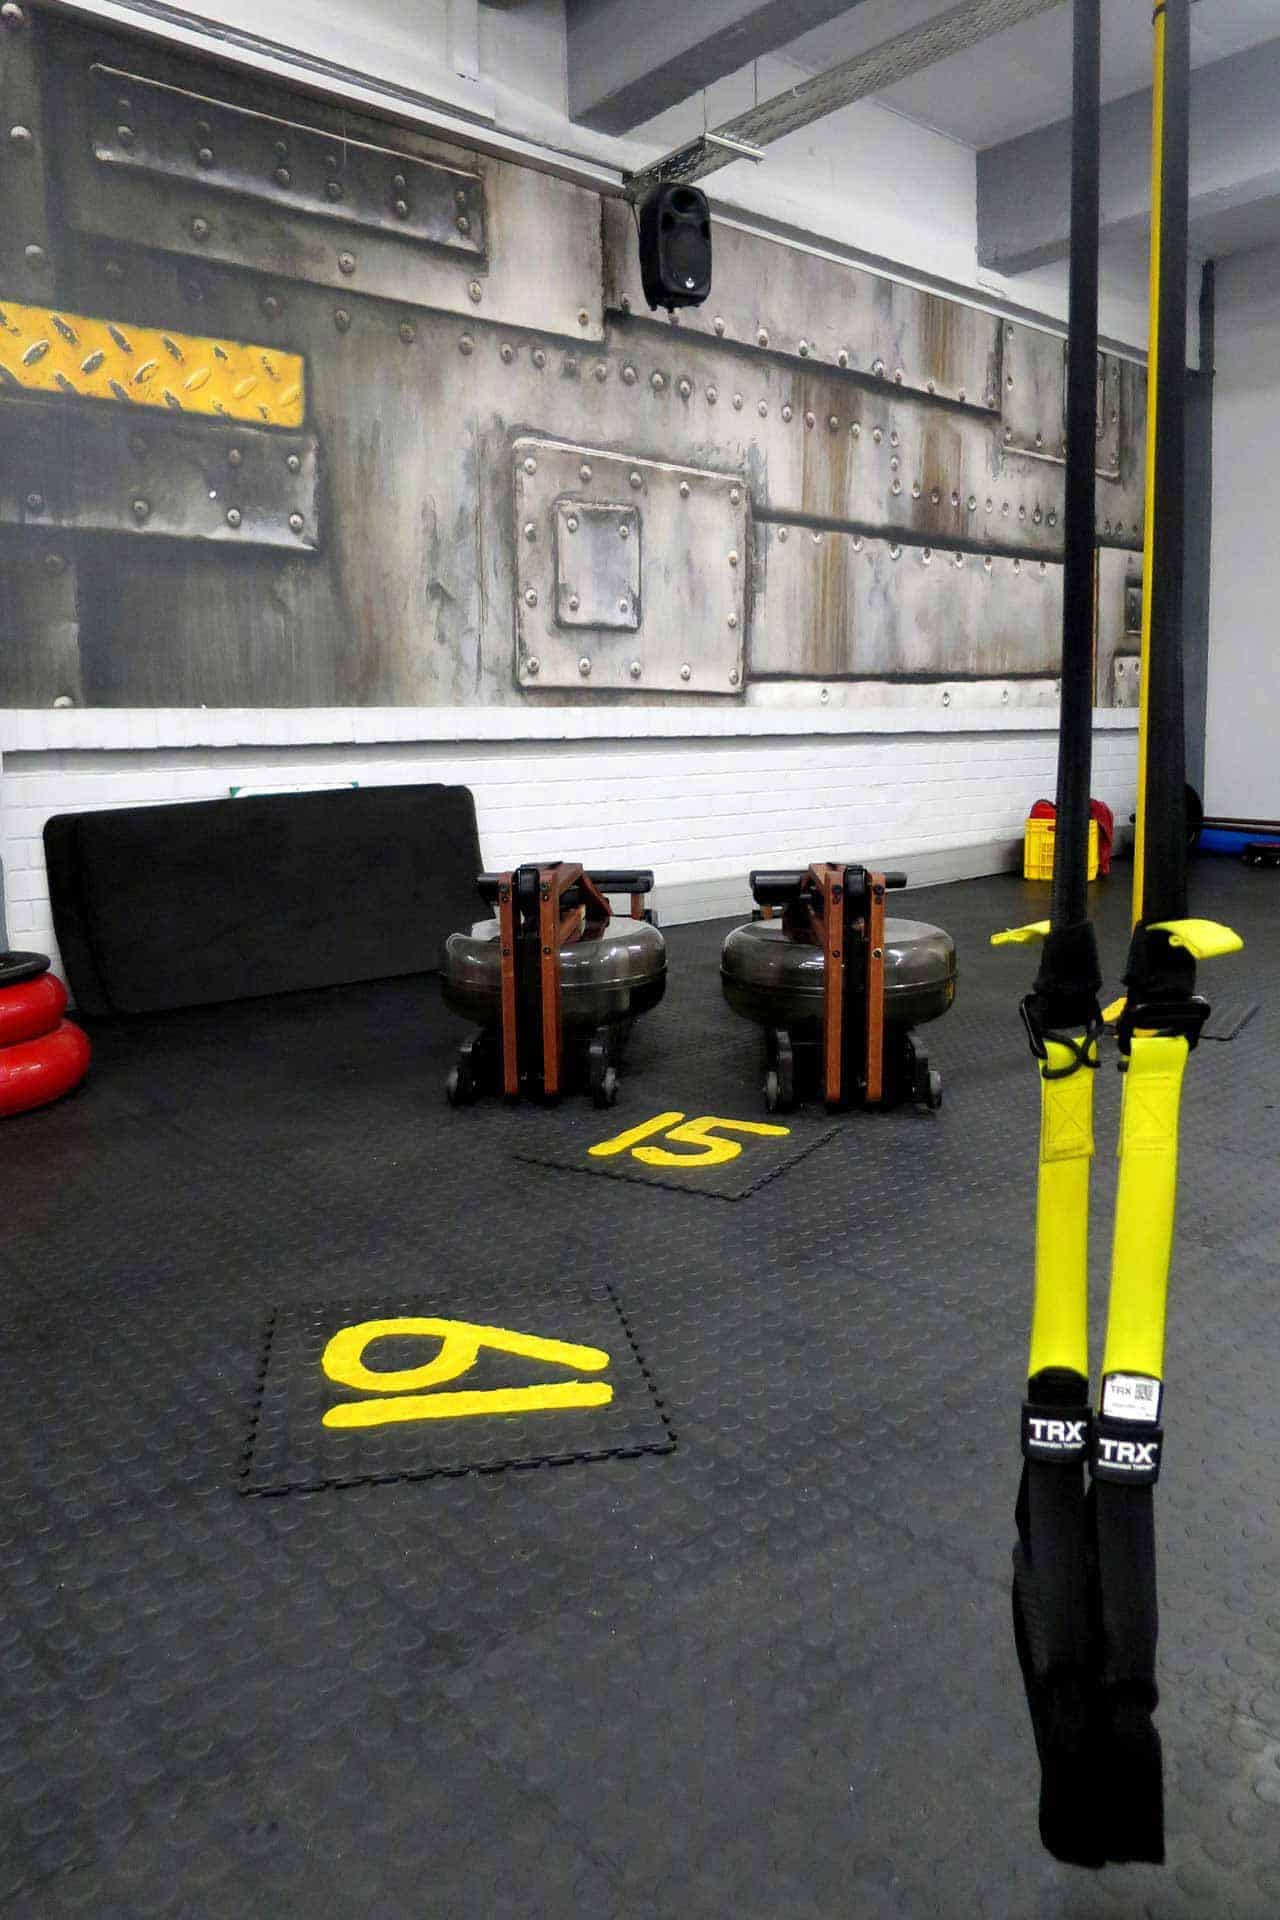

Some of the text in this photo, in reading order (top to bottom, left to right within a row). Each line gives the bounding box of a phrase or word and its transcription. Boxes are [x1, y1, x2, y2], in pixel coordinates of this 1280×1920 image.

[587, 1111, 791, 1168] 15
[1029, 1418, 1084, 1442] TRX
[1098, 1438, 1153, 1463] TRX
